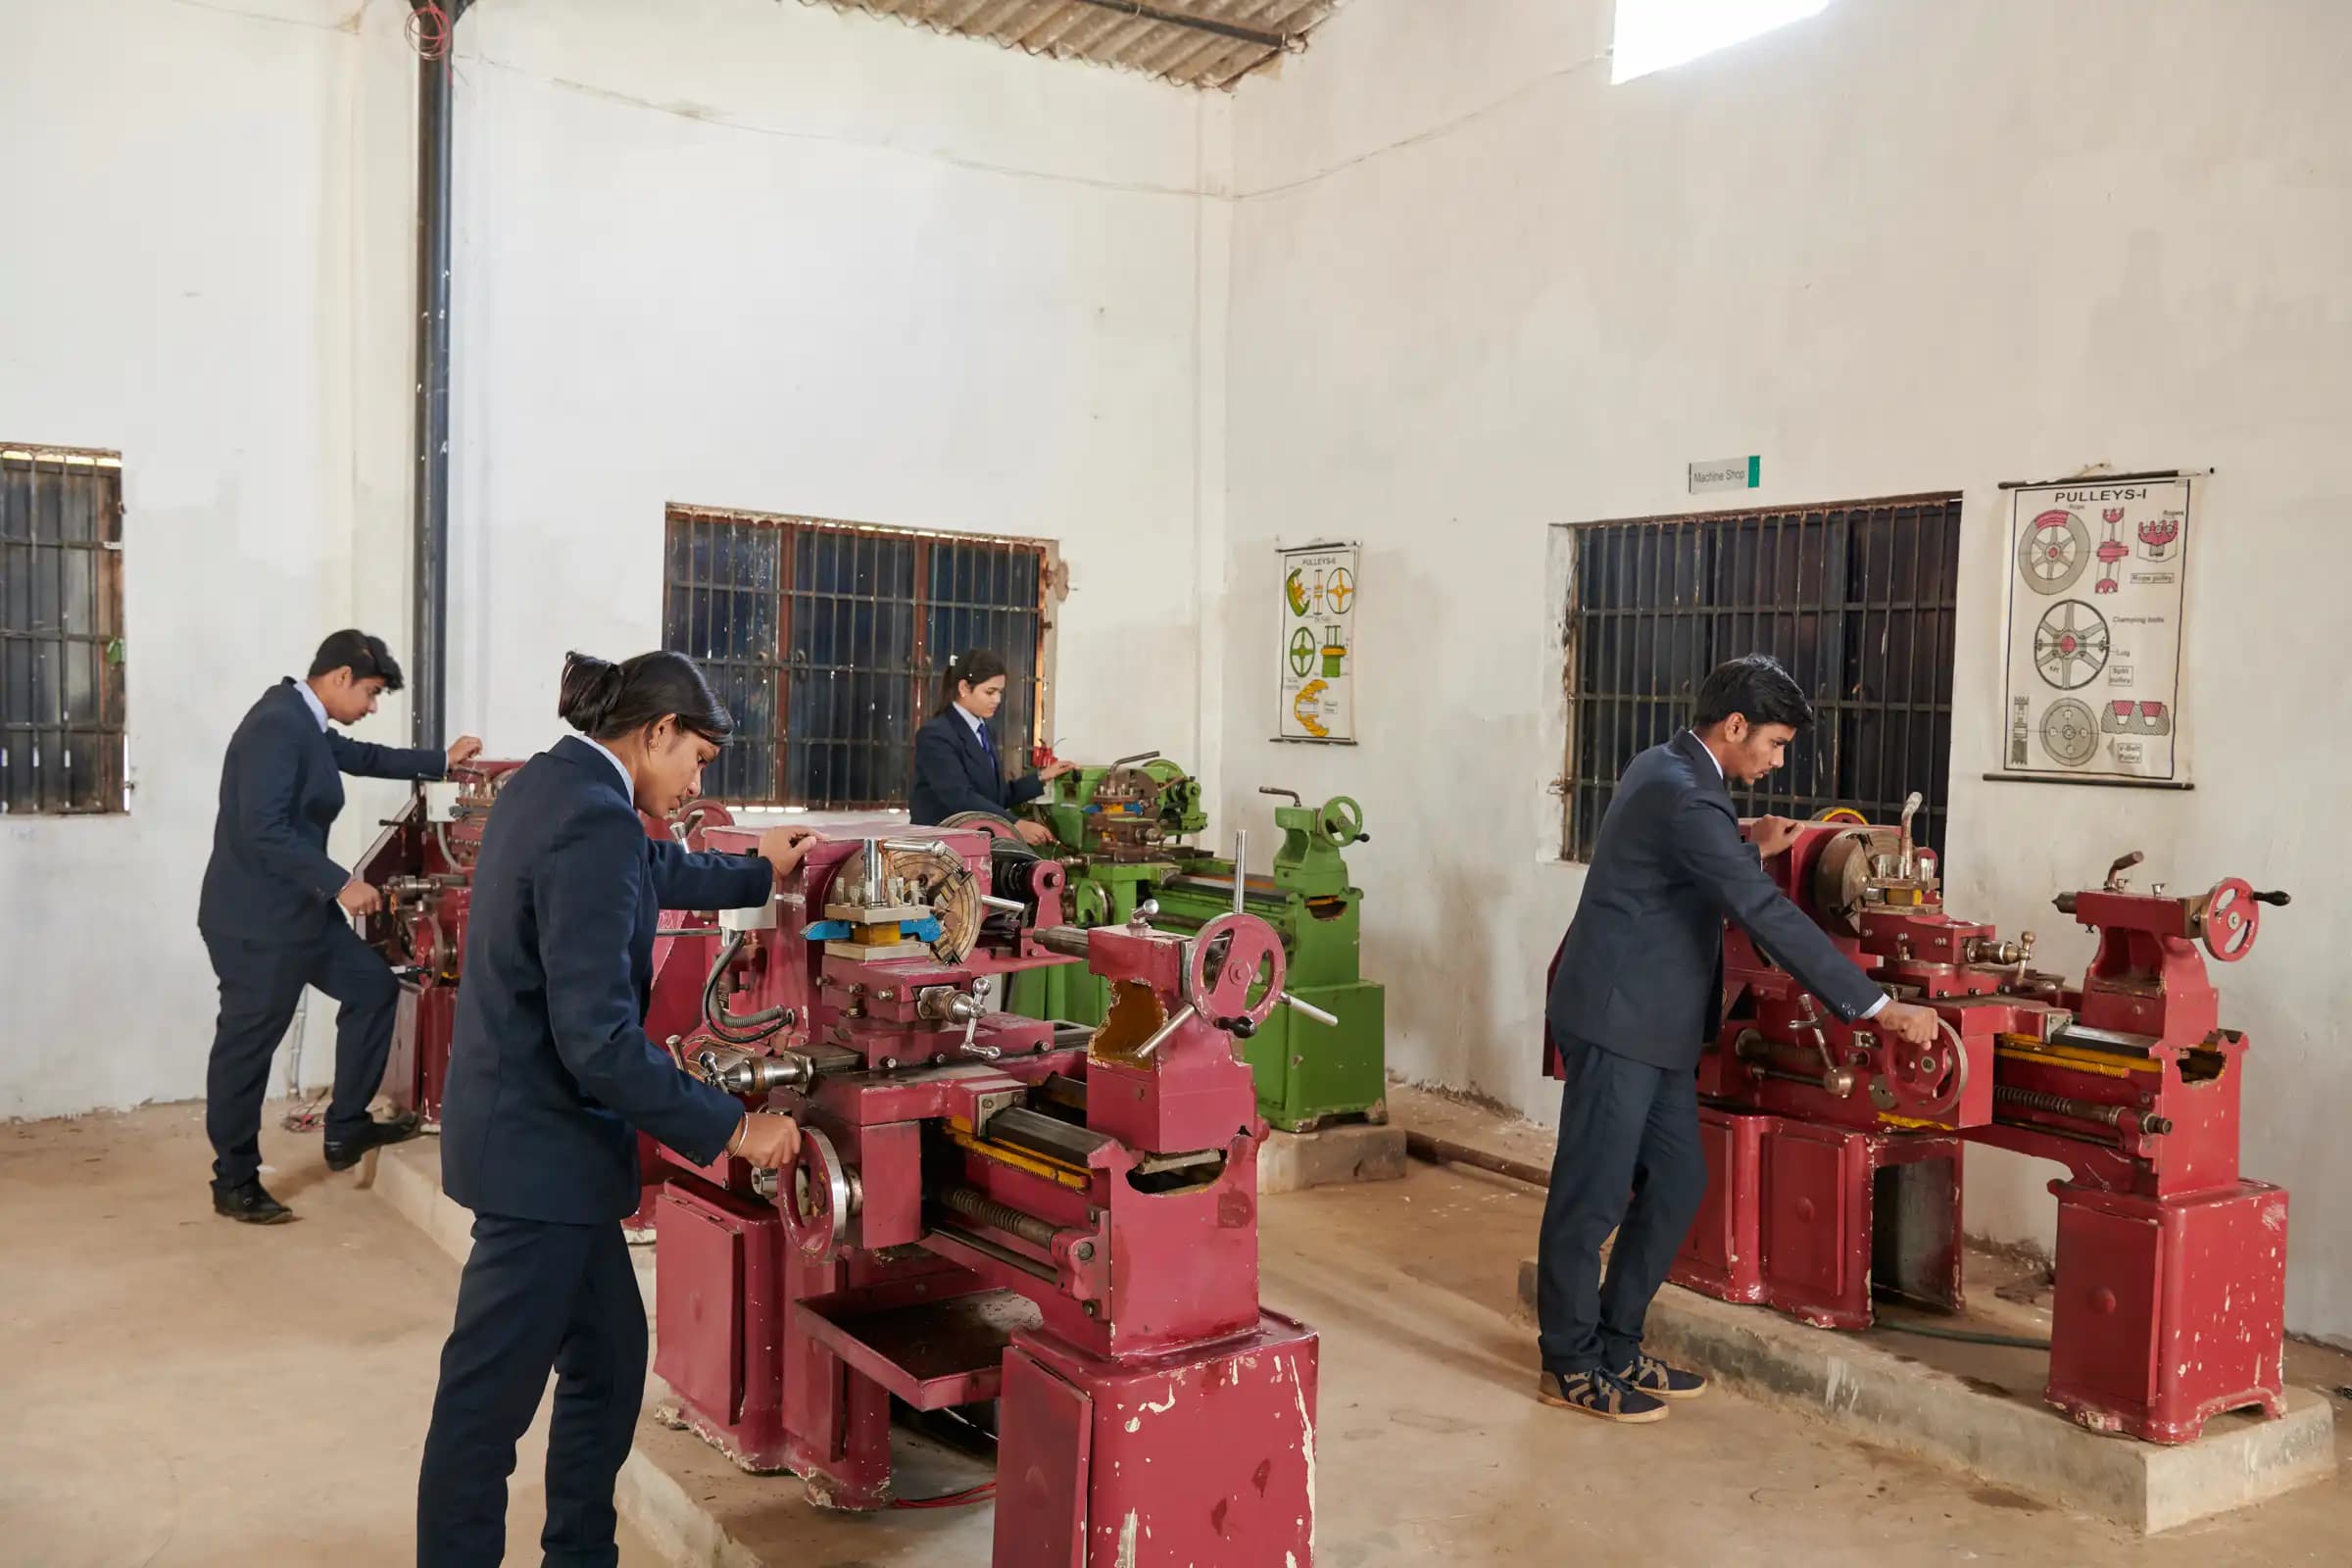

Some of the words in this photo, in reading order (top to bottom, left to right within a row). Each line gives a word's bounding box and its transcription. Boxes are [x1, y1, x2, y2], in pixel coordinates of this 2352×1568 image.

[1693, 471, 1725, 482] Machine
[1726, 469, 1745, 481] Shop
[2054, 488, 2147, 503] PULLEYS-I
